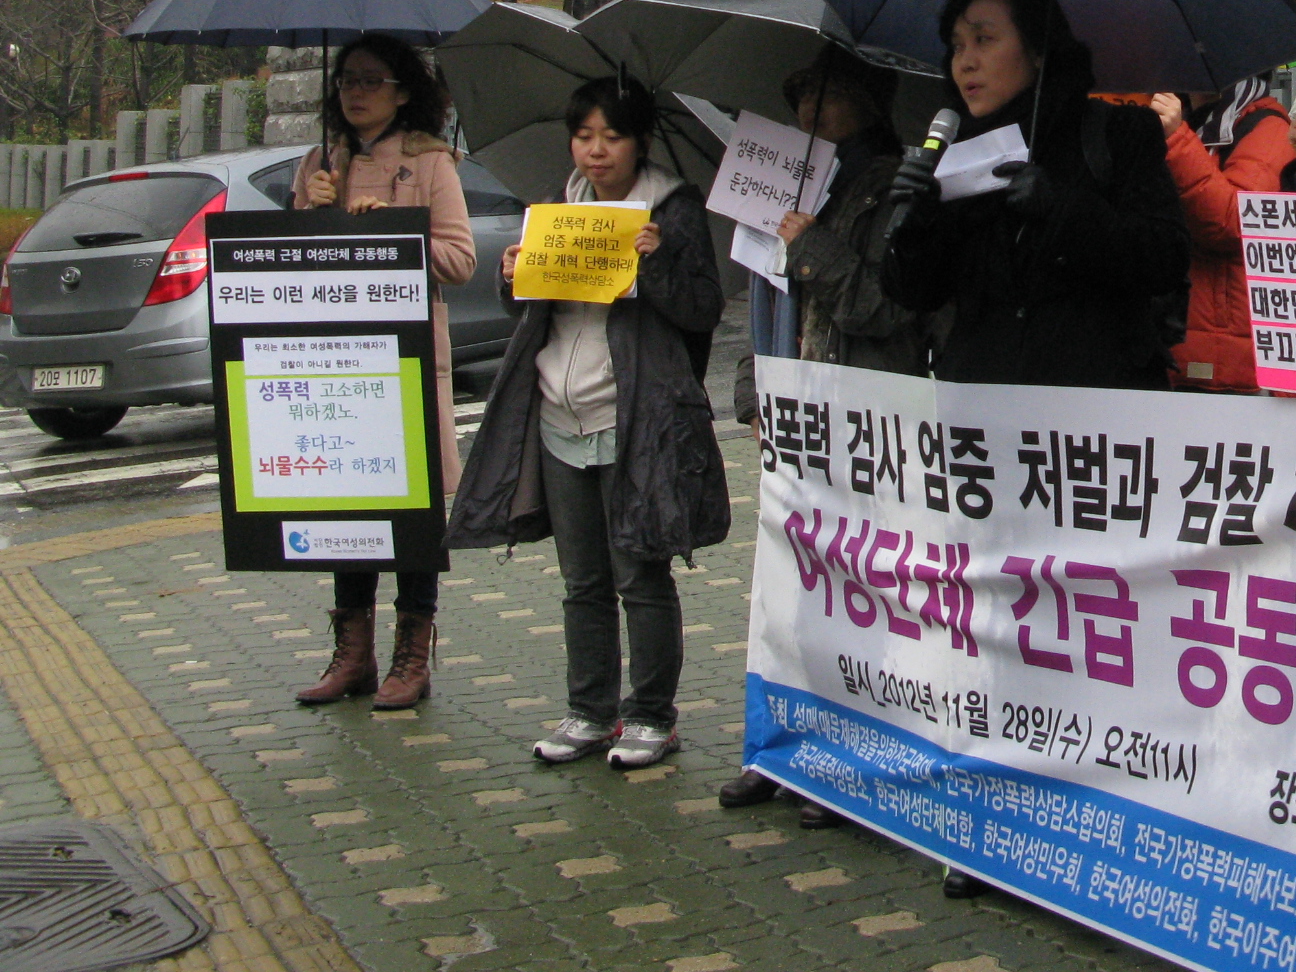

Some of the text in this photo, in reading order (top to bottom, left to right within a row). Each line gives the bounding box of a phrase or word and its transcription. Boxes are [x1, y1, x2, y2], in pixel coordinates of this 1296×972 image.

[737, 139, 779, 166] 성폭력이
[729, 172, 798, 209] 둔갑하다니??
[552, 216, 615, 233] 성폭력 검사
[544, 234, 620, 251] 엄중 처벌하고
[233, 247, 399, 262] 여성폭력 근절 여성단체 공동행동
[525, 251, 633, 272] 검찰 개혁 단행하라!
[542, 272, 614, 287] 한국성폭력상담소
[218, 283, 420, 305] 우리는 이런 세상을 원한다!
[254, 343, 278, 352] 우리는
[354, 341, 387, 350] 가해자가
[308, 360, 331, 369] 아니길
[67, 368, 97, 386] 1107
[259, 380, 385, 402] 성폭력 고소하면
[288, 403, 359, 422] 뭐하겠노.
[259, 456, 397, 477] 뇌물수수라 하겠지
[756, 392, 833, 486] 성폭력
[846, 408, 906, 503] 검사
[917, 420, 995, 520] 엄중
[1017, 430, 1158, 539] 처벌과
[1177, 442, 1274, 547] 검찰
[324, 538, 385, 548] 한국여성의전화
[784, 507, 979, 658] 여성단체
[1000, 555, 1139, 687] 긴급
[941, 690, 990, 739] 11월
[1001, 701, 1093, 764] 28일(수)
[1095, 727, 1197, 794] 오전11시
